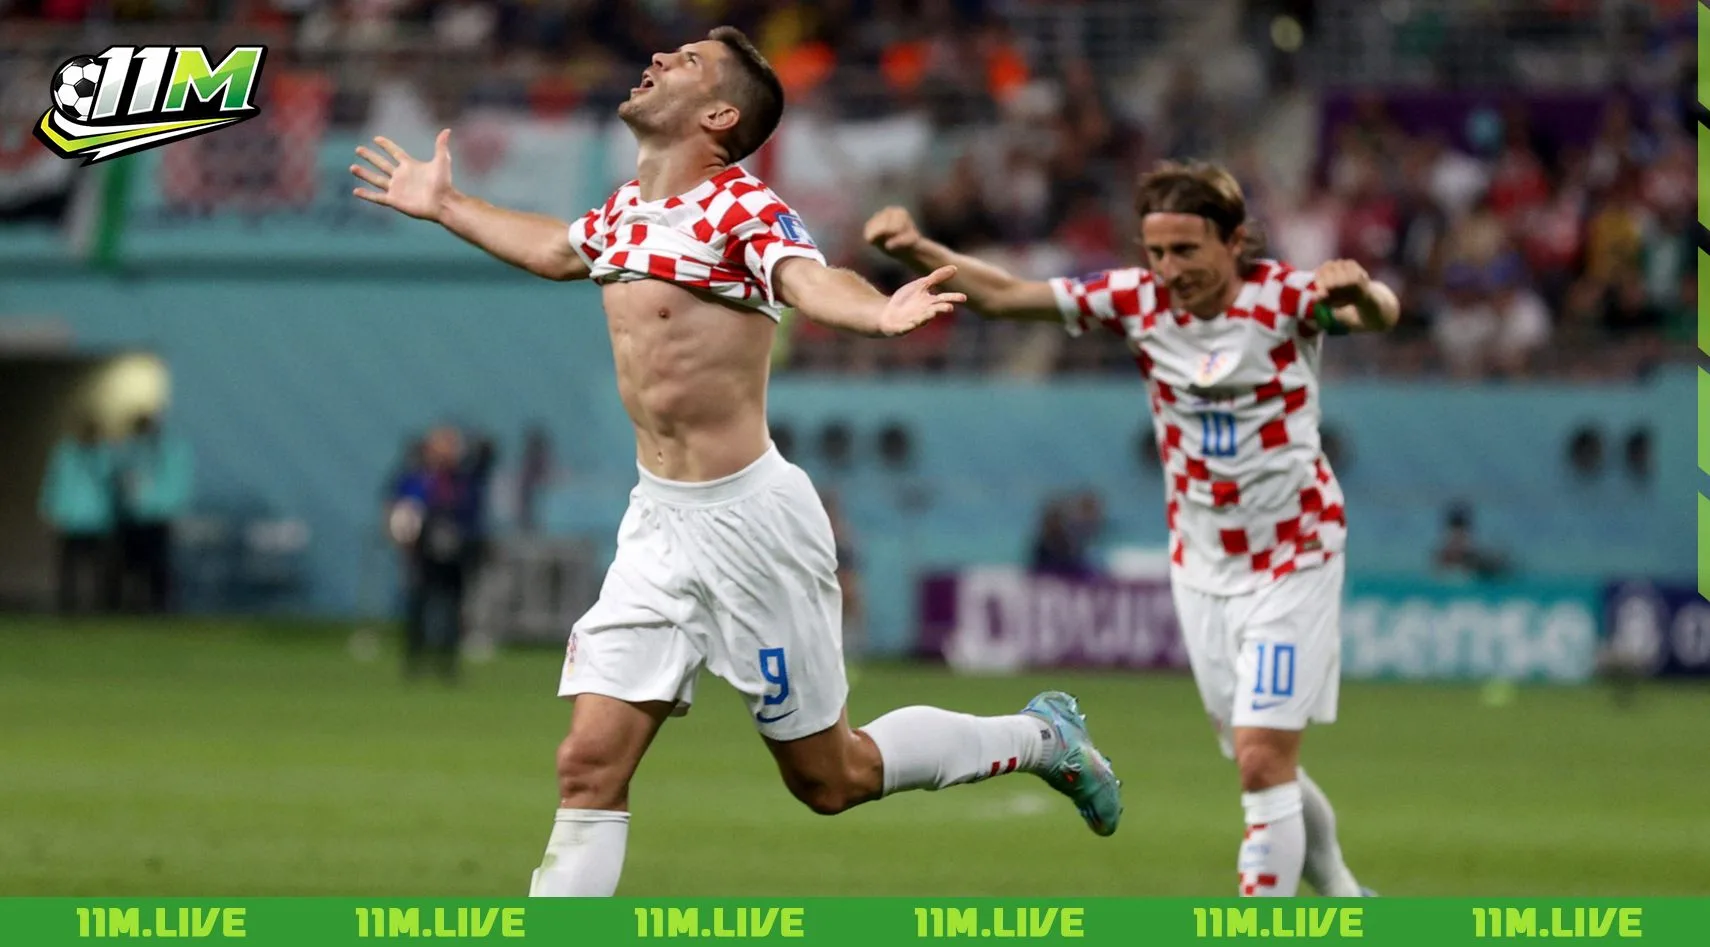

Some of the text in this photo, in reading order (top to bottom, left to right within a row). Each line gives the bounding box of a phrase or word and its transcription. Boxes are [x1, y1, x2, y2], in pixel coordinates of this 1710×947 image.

[1200, 411, 1238, 458] 10
[759, 647, 790, 706] 9
[1253, 643, 1297, 697] 10
